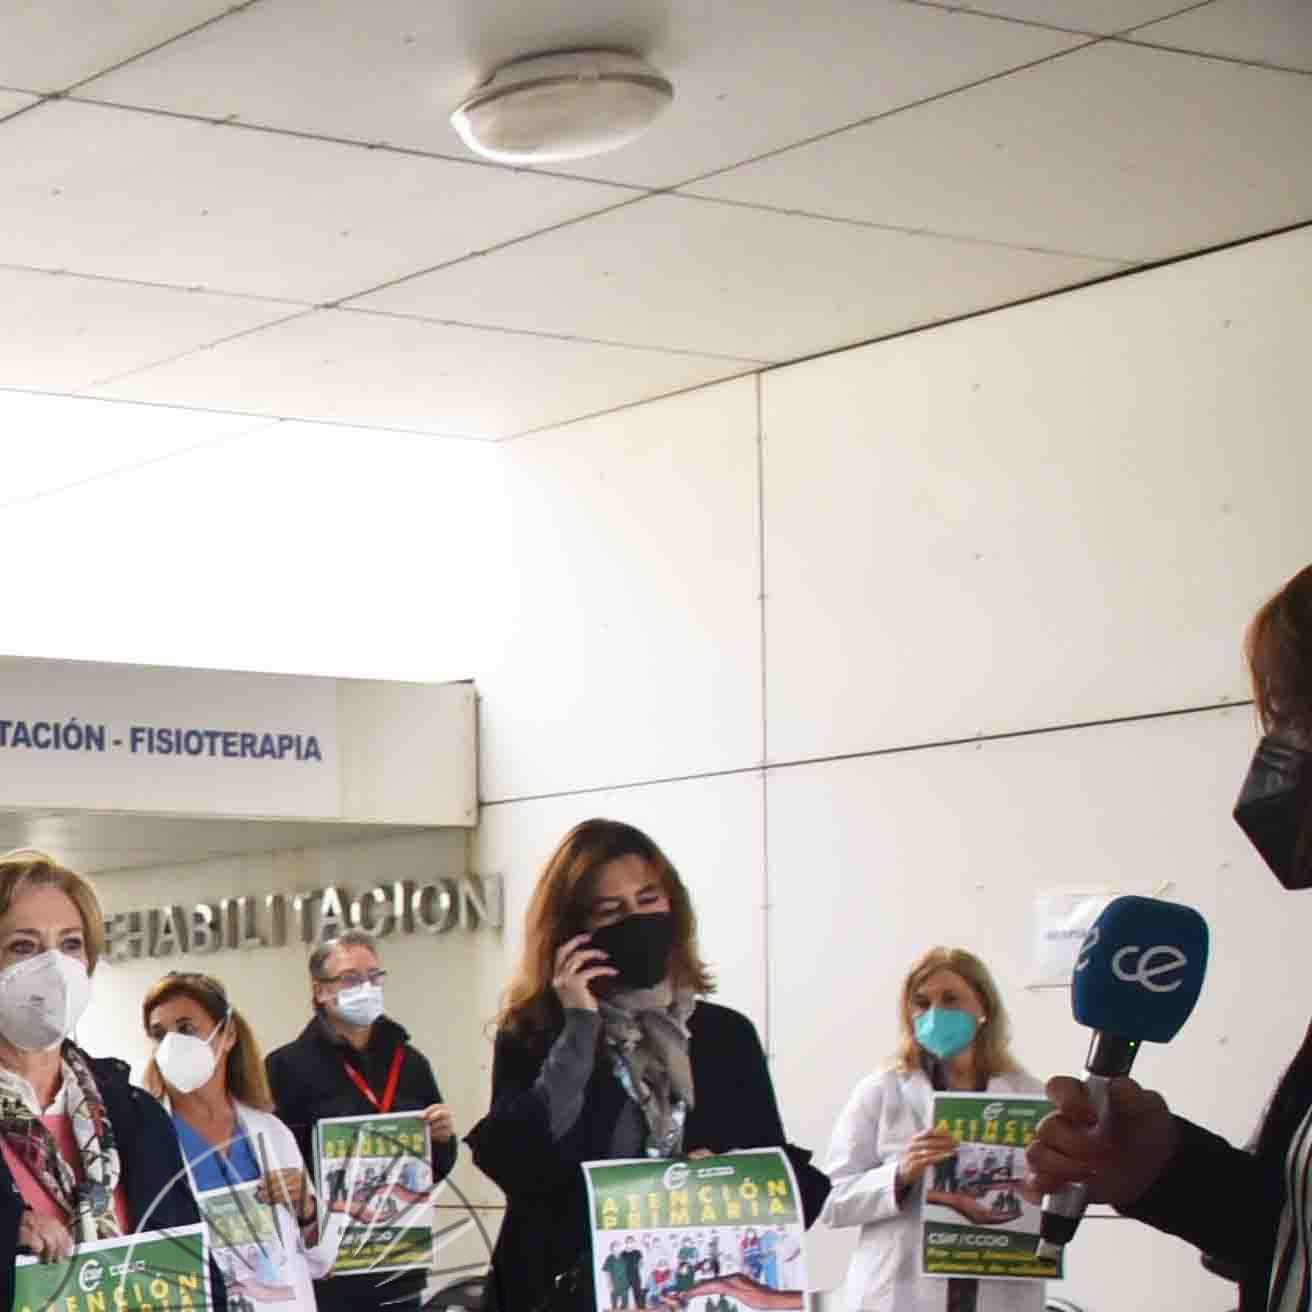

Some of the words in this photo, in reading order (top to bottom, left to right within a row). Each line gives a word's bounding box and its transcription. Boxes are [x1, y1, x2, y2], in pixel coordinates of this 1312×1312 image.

[130, 726, 322, 761] FISIOTERAPIA
[103, 873, 505, 962] EHABILITACION
[602, 1178, 787, 1213] ATENCIÓN
